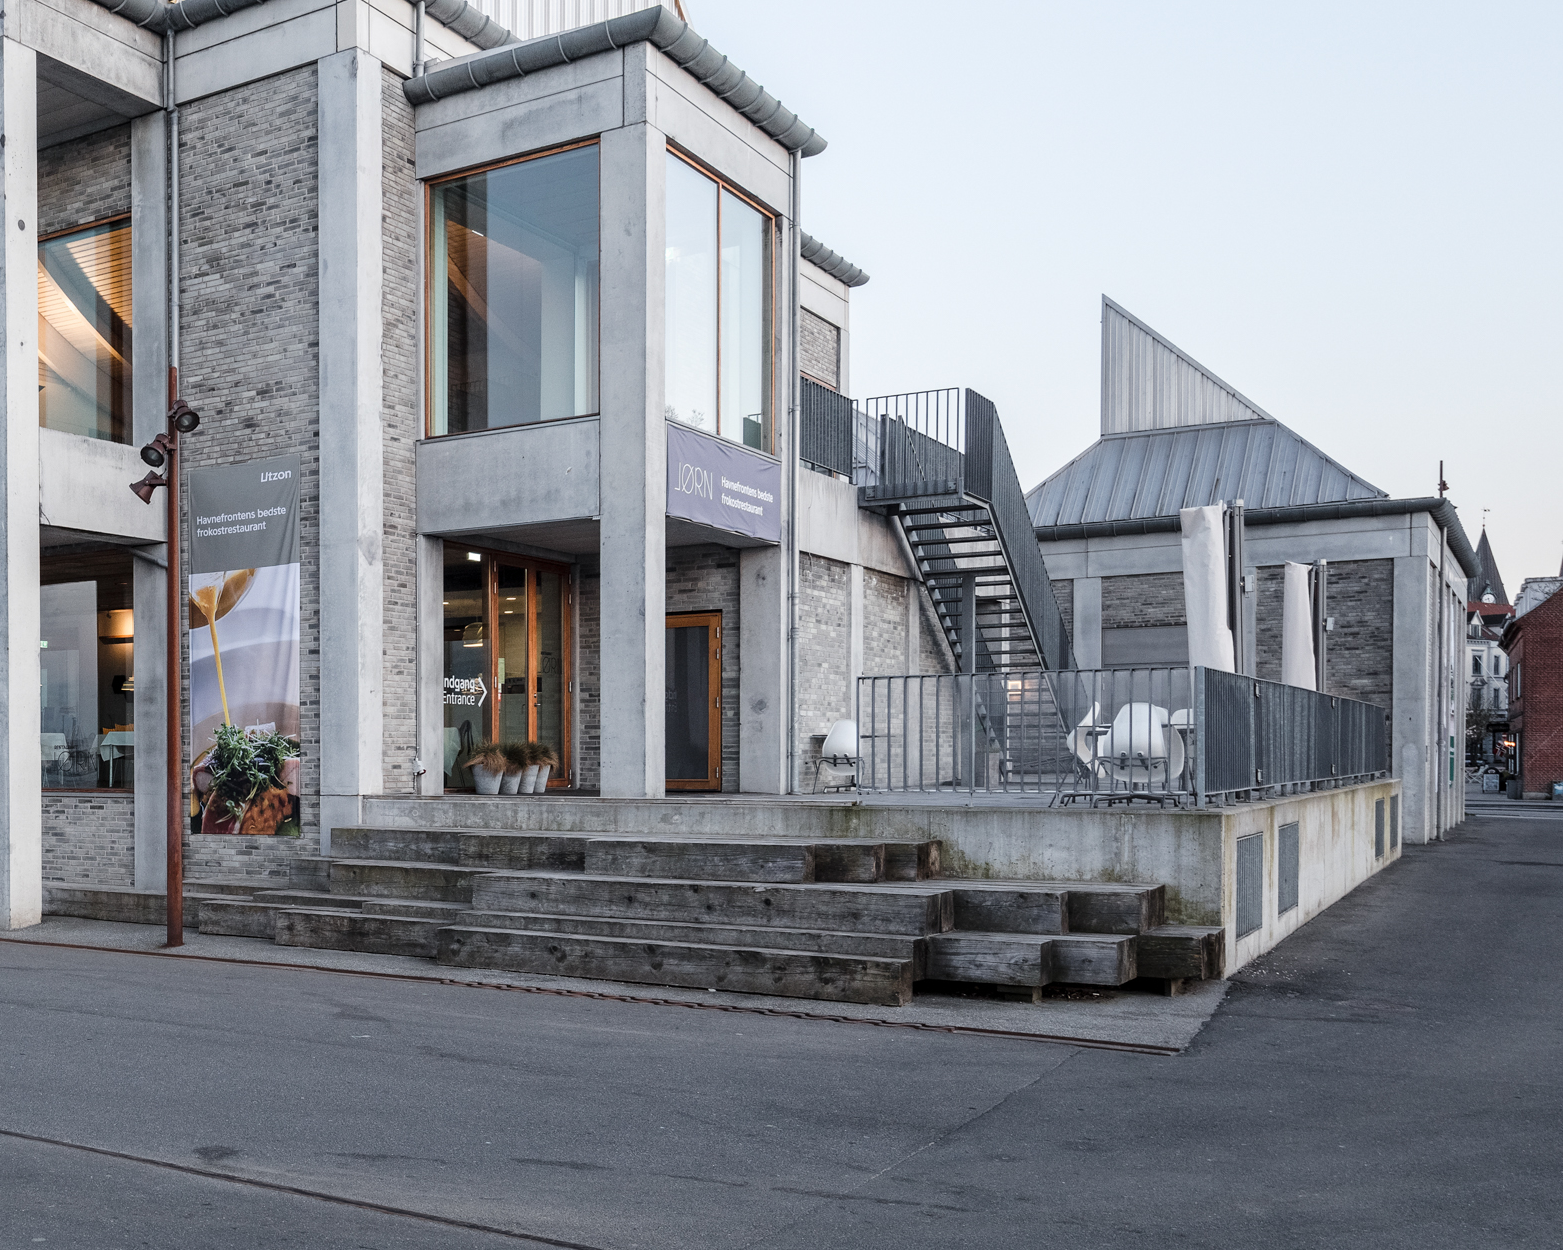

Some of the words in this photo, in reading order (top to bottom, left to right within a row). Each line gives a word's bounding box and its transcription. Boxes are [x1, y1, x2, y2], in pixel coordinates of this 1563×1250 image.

[674, 462, 713, 500] JØRN
[721, 475, 757, 498] Havnefrontens
[757, 488, 773, 503] bedste
[721, 493, 763, 516] frokostrestaurant
[196, 511, 255, 525] Havnefrontens
[257, 506, 287, 518] bedste
[196, 521, 266, 537] frokostrestaurant
[444, 675, 475, 692] ndgang
